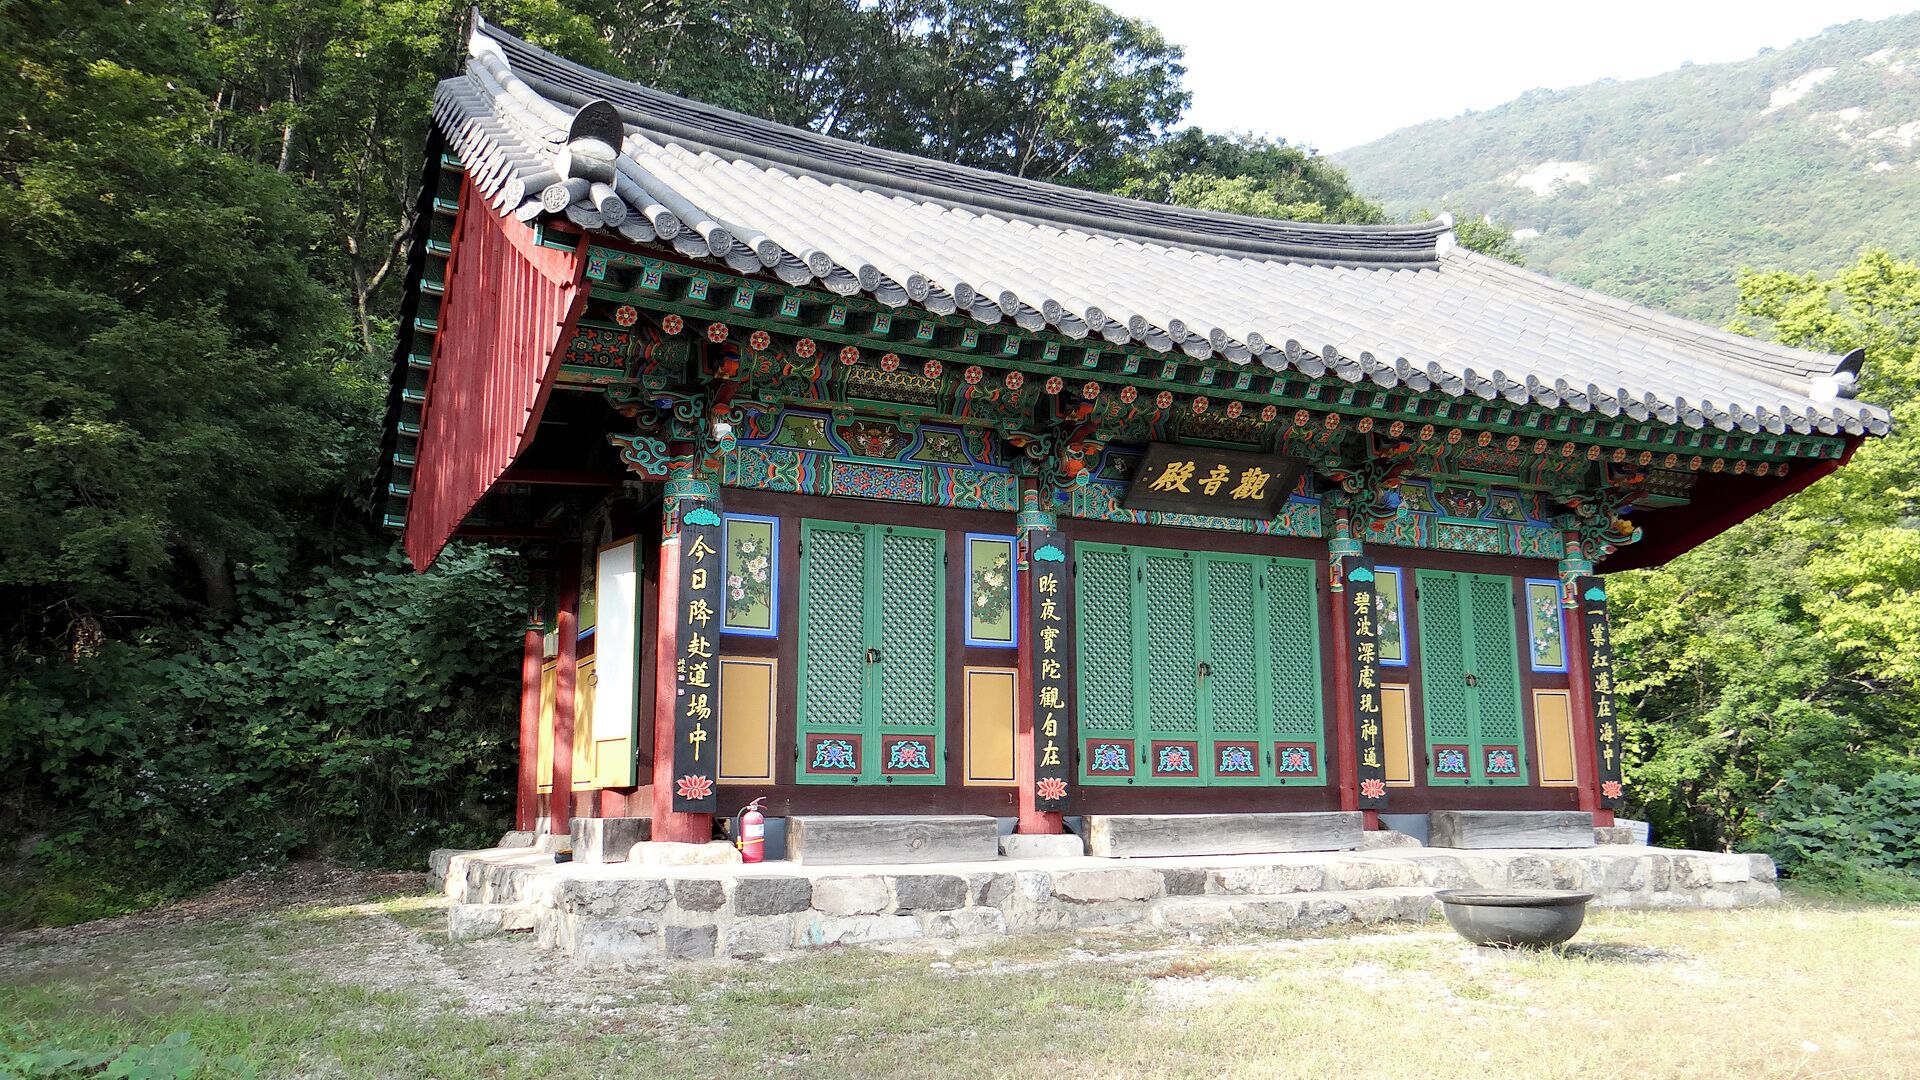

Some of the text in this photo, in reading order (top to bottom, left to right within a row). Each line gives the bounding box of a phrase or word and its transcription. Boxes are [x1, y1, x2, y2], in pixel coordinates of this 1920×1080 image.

[686, 534, 716, 761] 今日降赴道場中
[1039, 572, 1065, 767] 昨夜寶陀觀自在
[1587, 610, 1615, 770] 一葉紅蓮在海中
